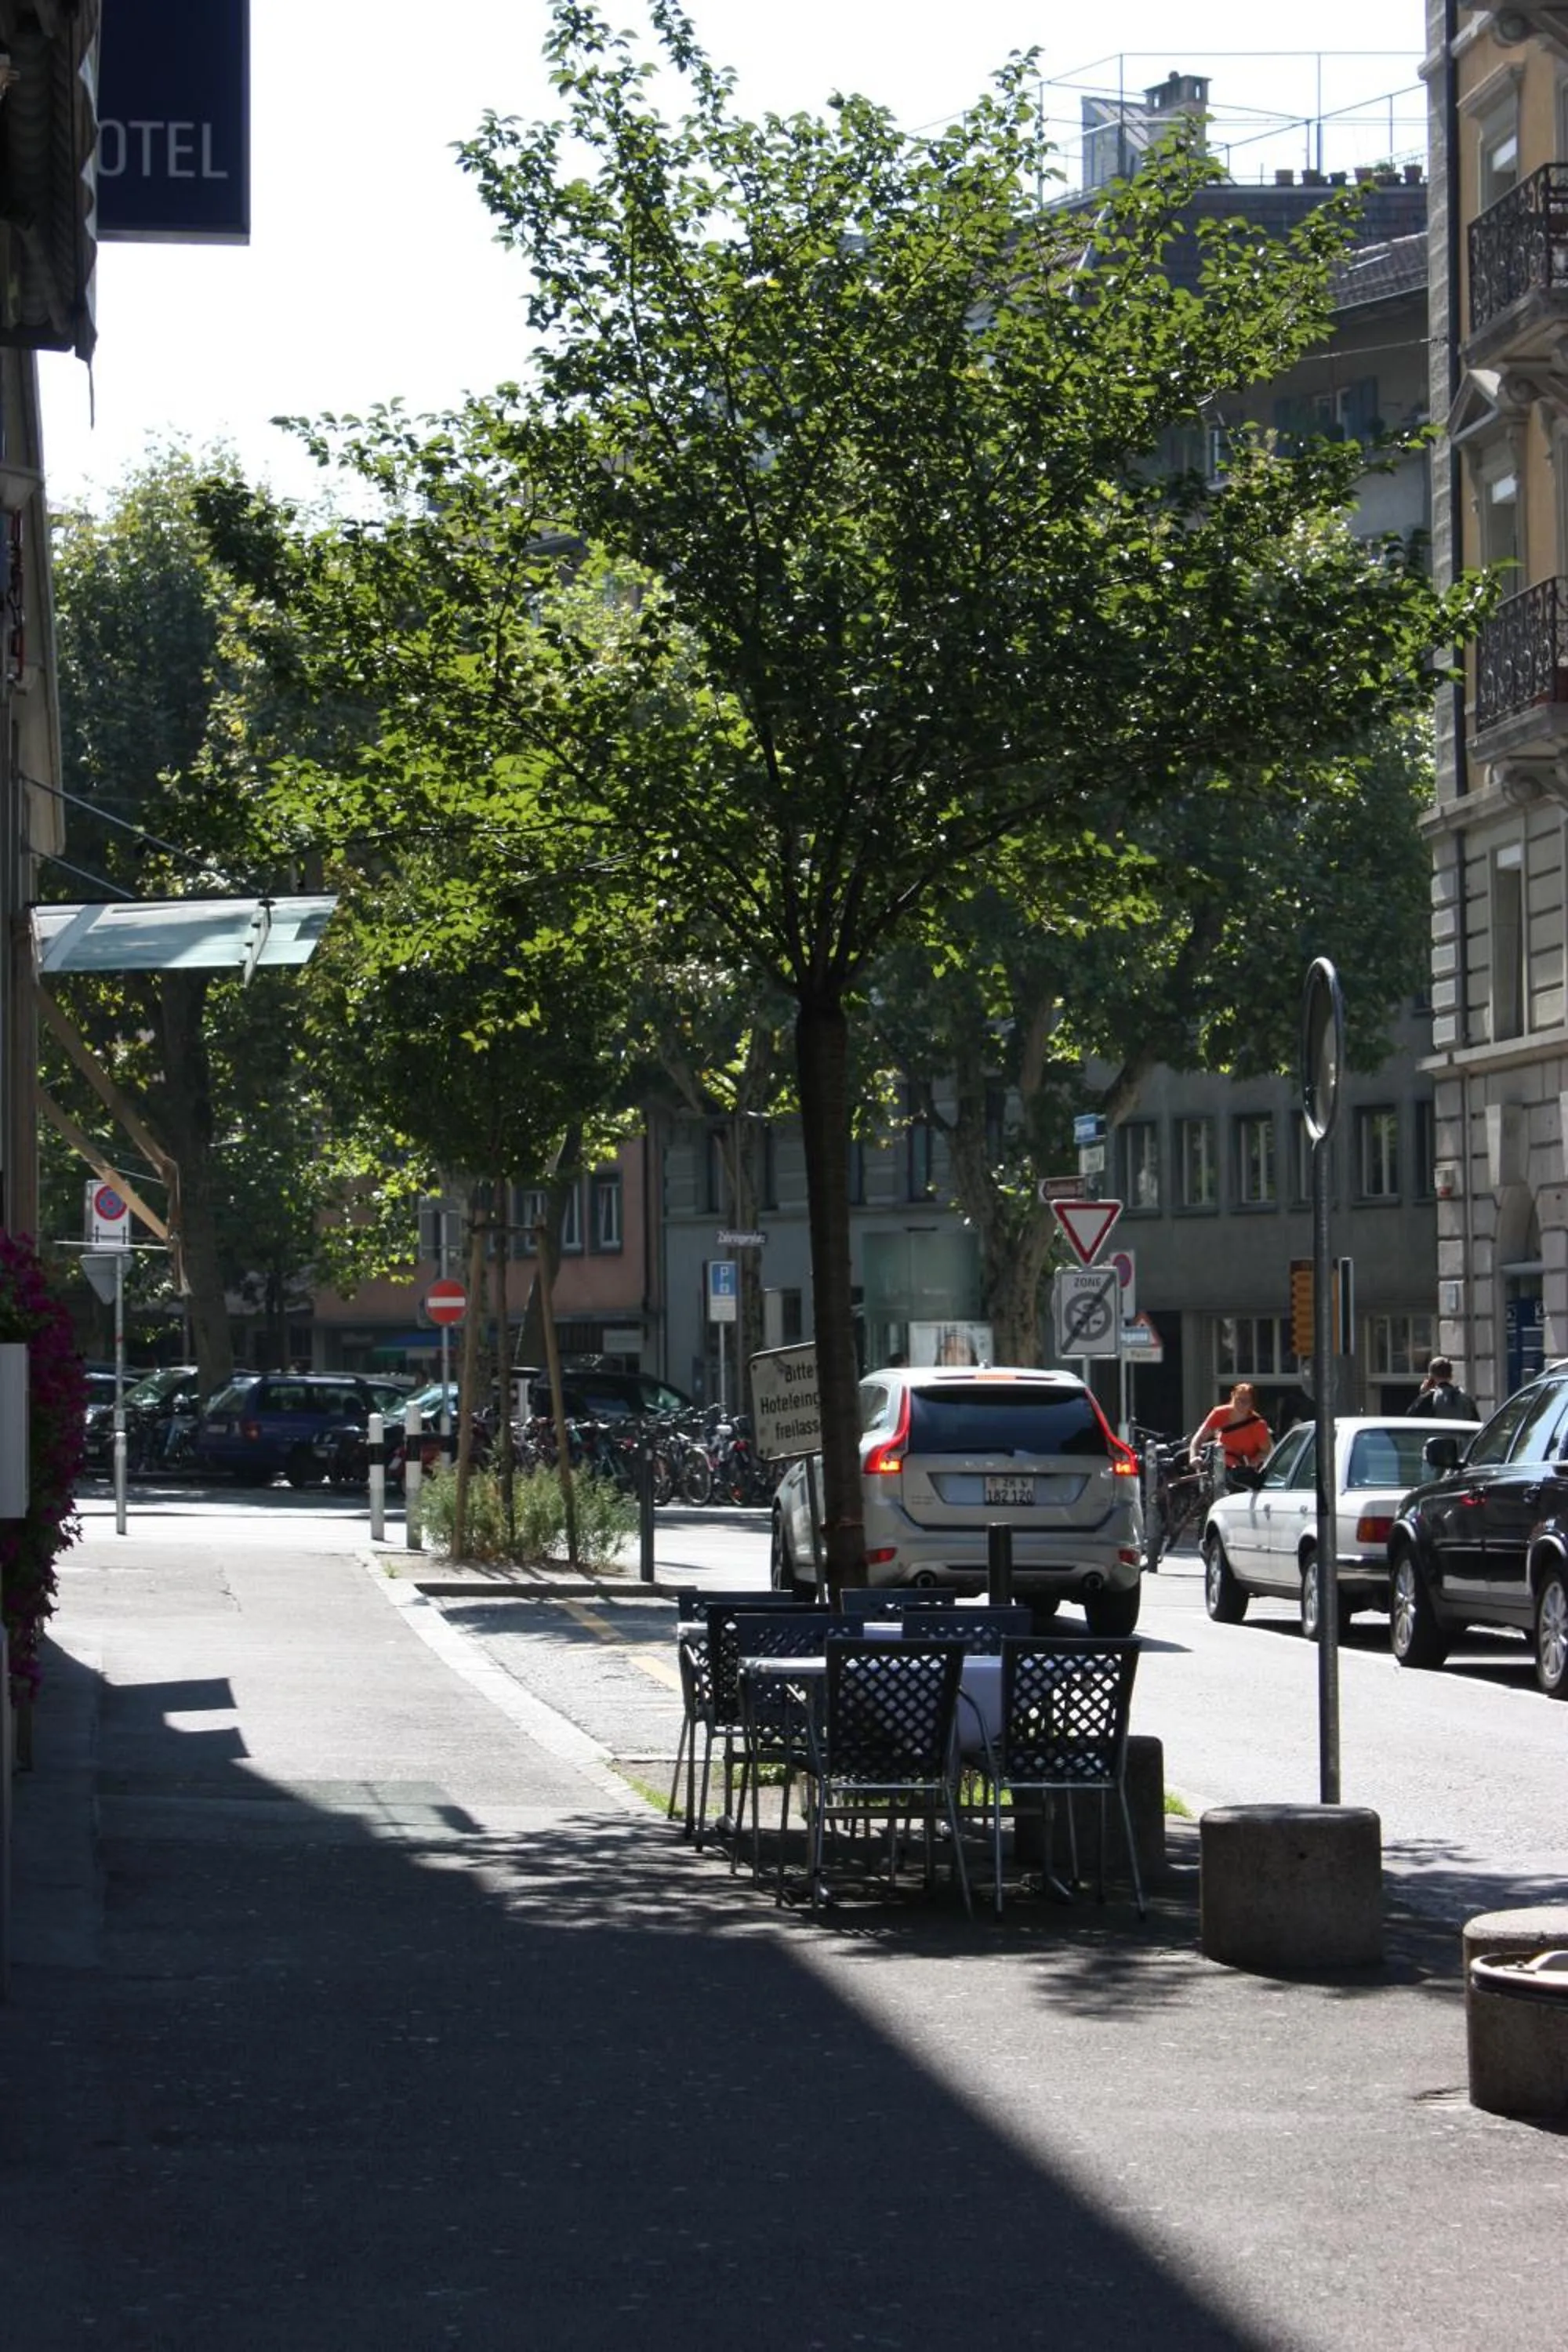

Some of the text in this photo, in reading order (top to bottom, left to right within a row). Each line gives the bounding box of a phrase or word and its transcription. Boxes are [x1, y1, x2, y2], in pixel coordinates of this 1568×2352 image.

[96, 119, 229, 179] OTEL
[1074, 1276, 1102, 1288] ZONE
[786, 1362, 814, 1382] Bitte
